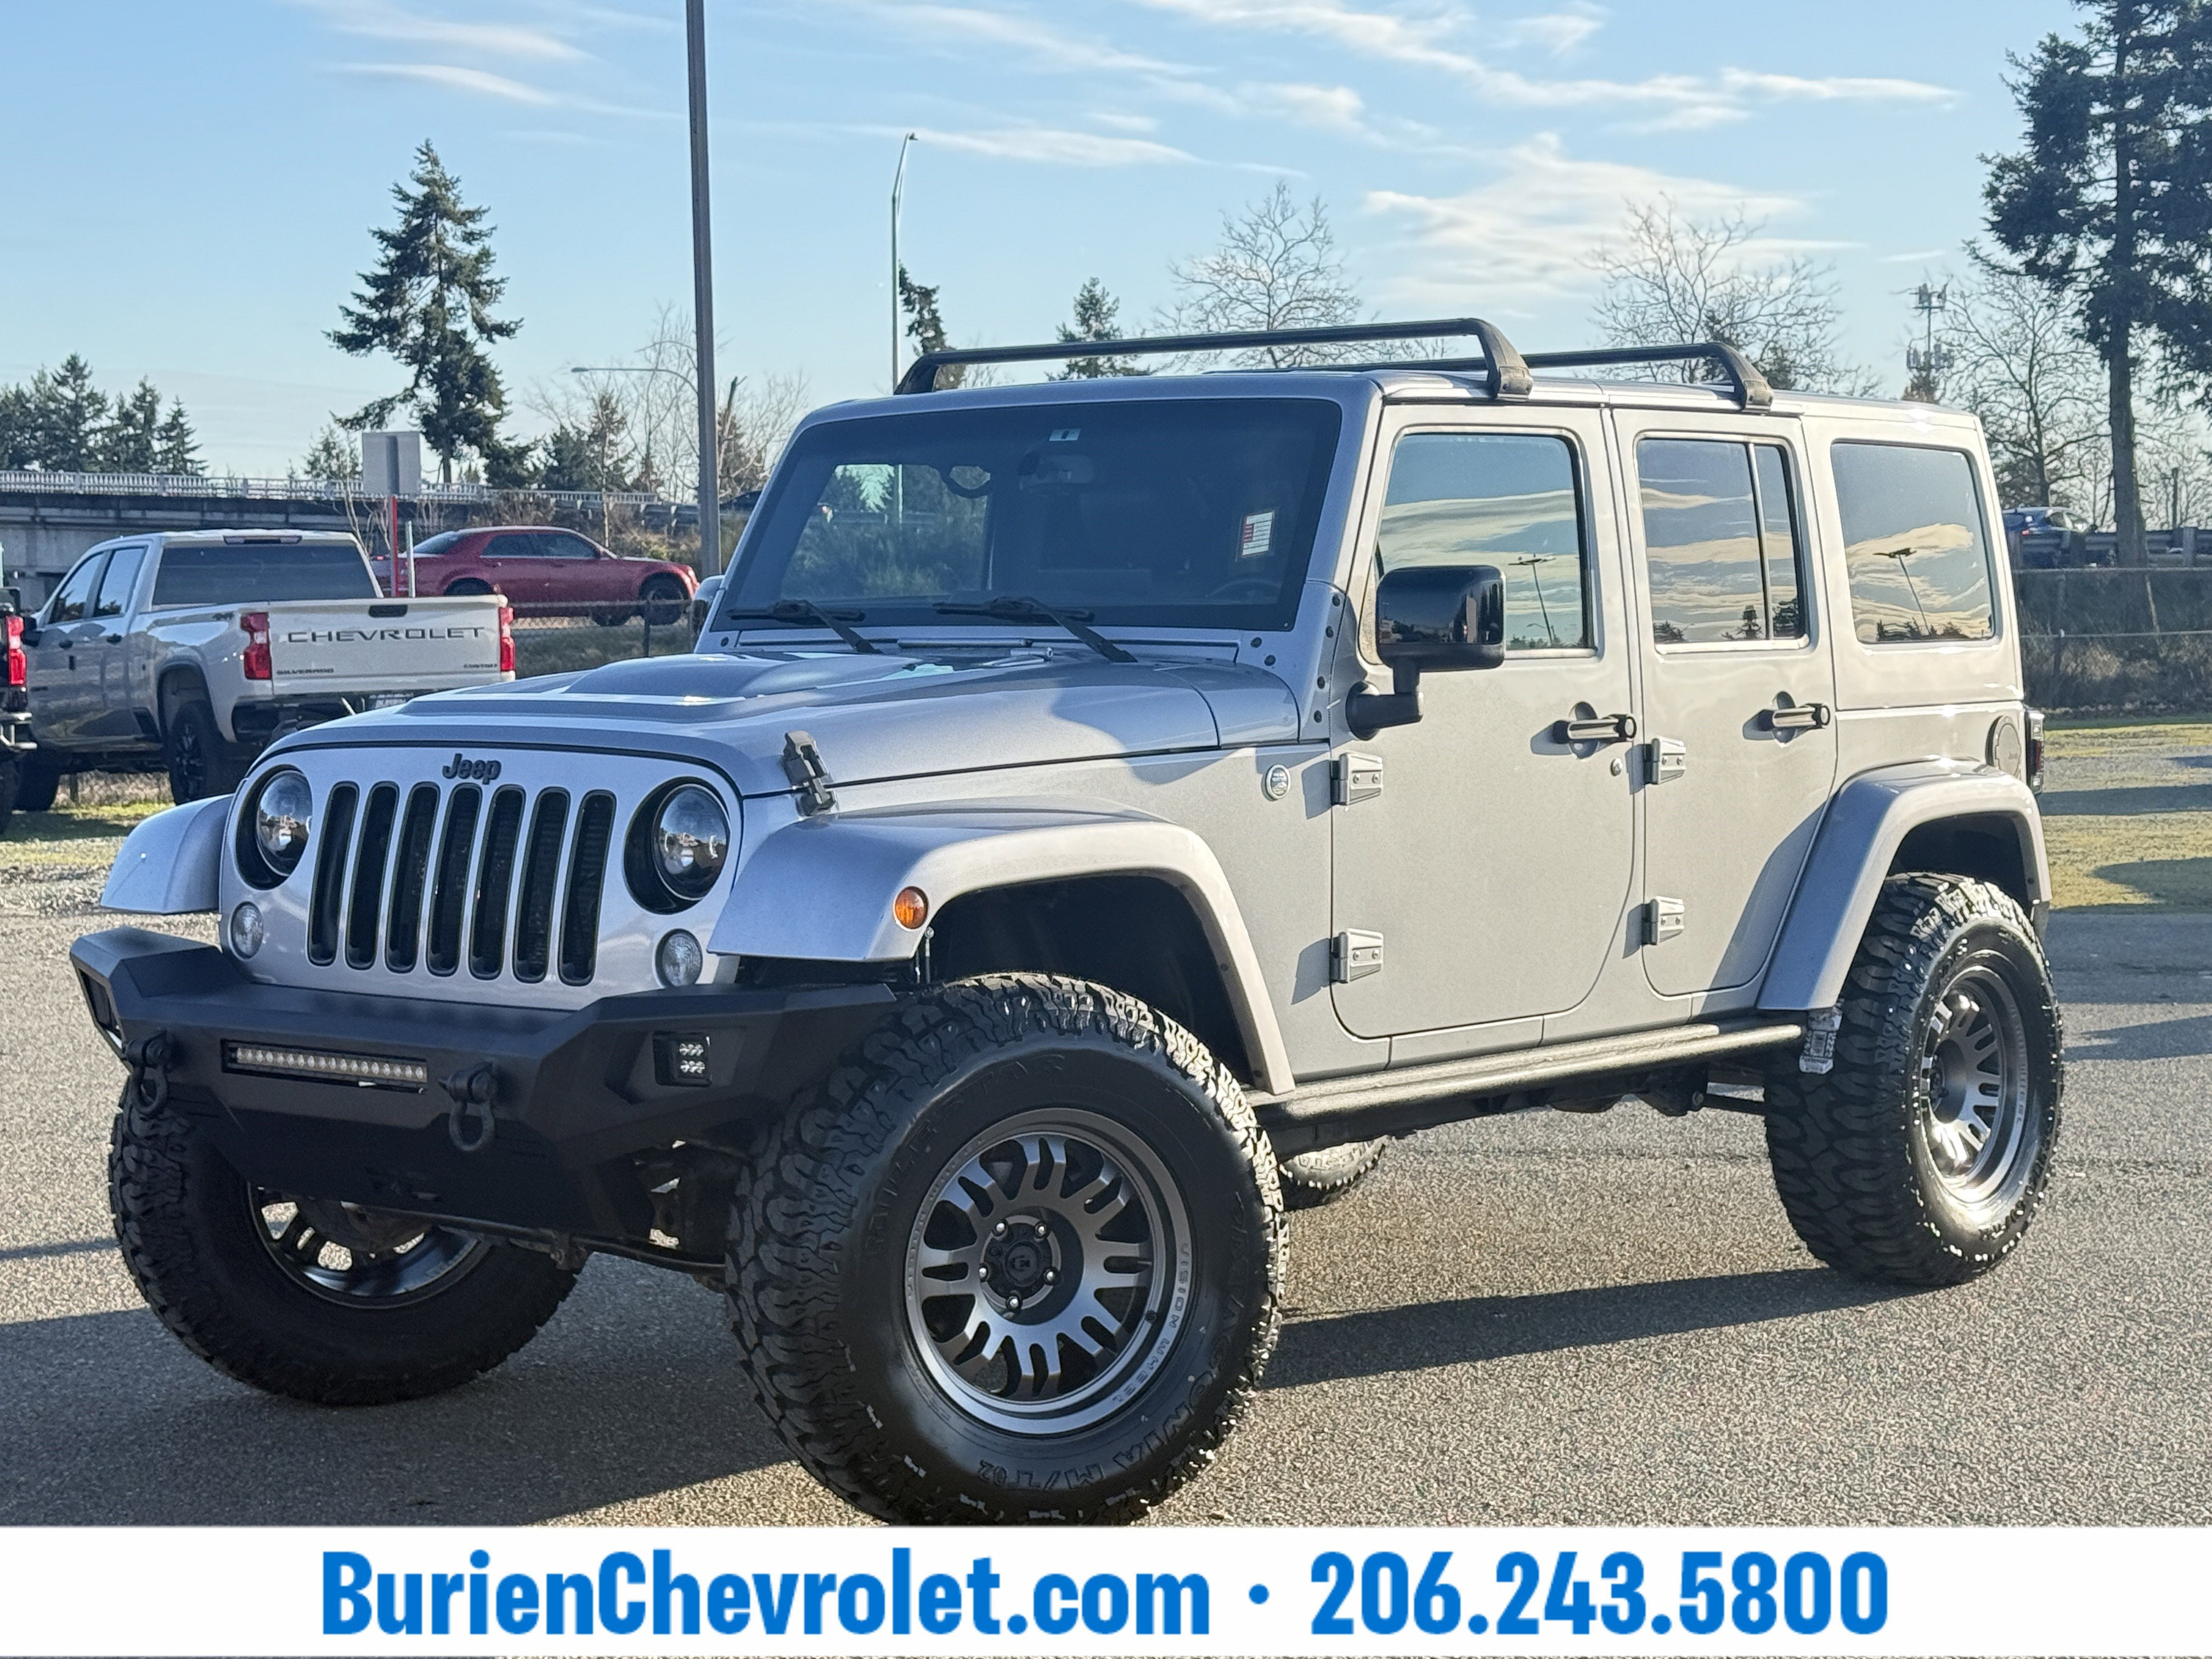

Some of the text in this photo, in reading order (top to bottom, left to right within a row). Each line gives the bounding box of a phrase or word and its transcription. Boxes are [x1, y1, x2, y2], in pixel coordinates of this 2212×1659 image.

[287, 626, 486, 643] CHEVROLET
[442, 753, 502, 785] Jeep
[1112, 1337, 1171, 1403] WHEEL
